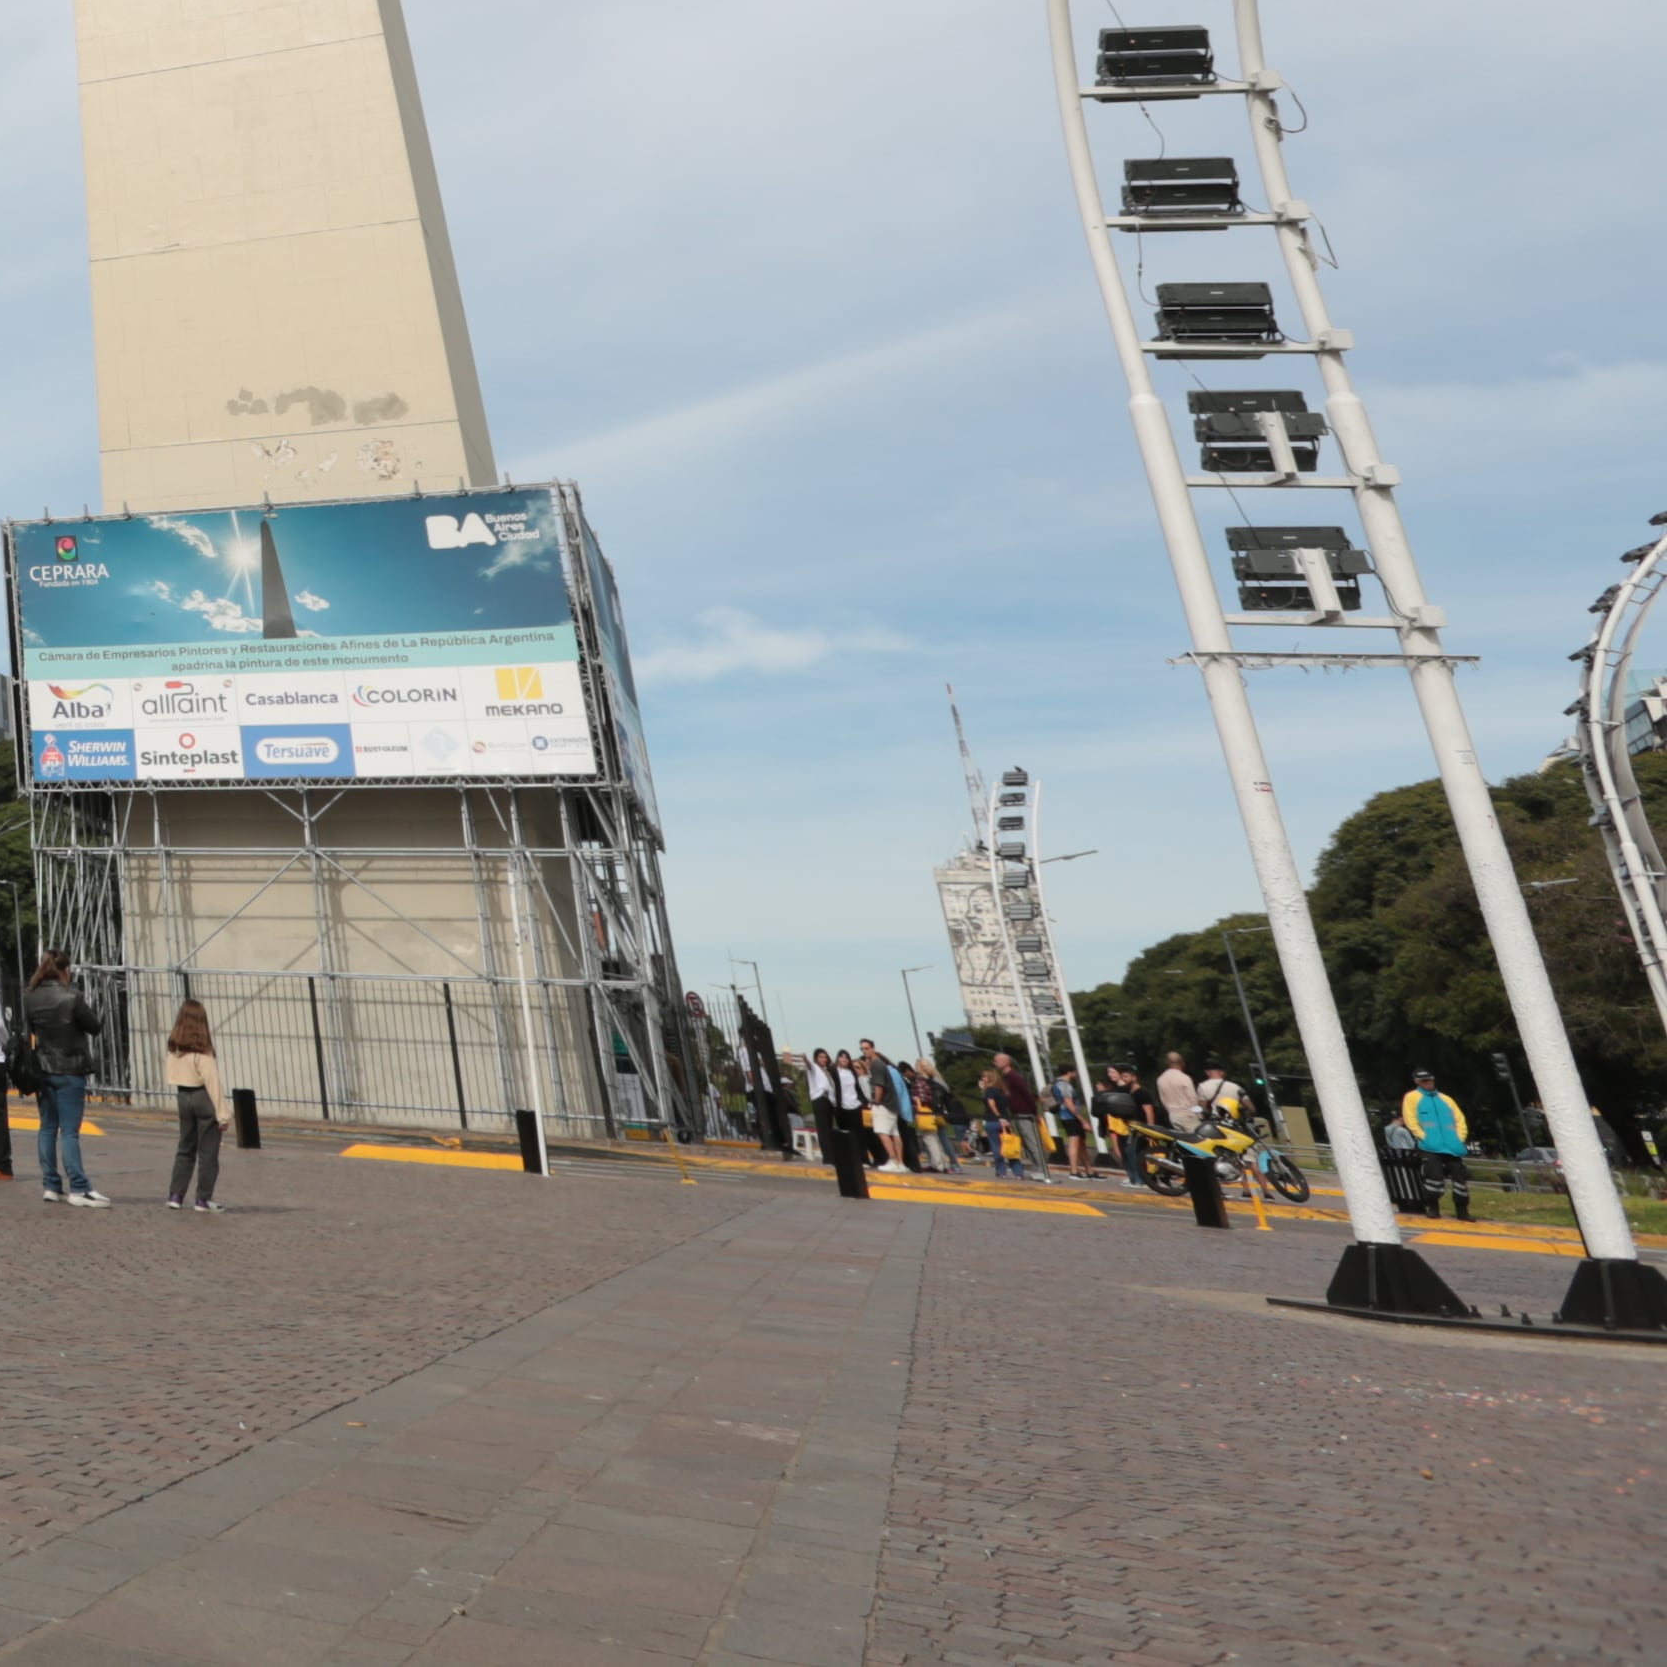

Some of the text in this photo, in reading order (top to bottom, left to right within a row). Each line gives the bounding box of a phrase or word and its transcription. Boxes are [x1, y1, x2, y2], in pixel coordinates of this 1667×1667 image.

[485, 512, 527, 523] Buenos
[425, 512, 498, 550] BA
[494, 521, 525, 532] Aires
[498, 529, 540, 541] Ciudad
[29, 563, 109, 582] CEPRARA
[39, 579, 70, 588] Fundada
[38, 631, 555, 662] Cámara de Empresarios Pintores y Restauraciones Afines de La República Argentina
[171, 654, 408, 672] apadrina la pintura de este monumento
[245, 691, 338, 706] Casablanca
[52, 701, 104, 719] Alba
[485, 702, 563, 717] MEKANO
[68, 740, 127, 754] SHERWIN
[263, 743, 330, 759] Tersuave
[140, 750, 239, 767] Sinteplast
